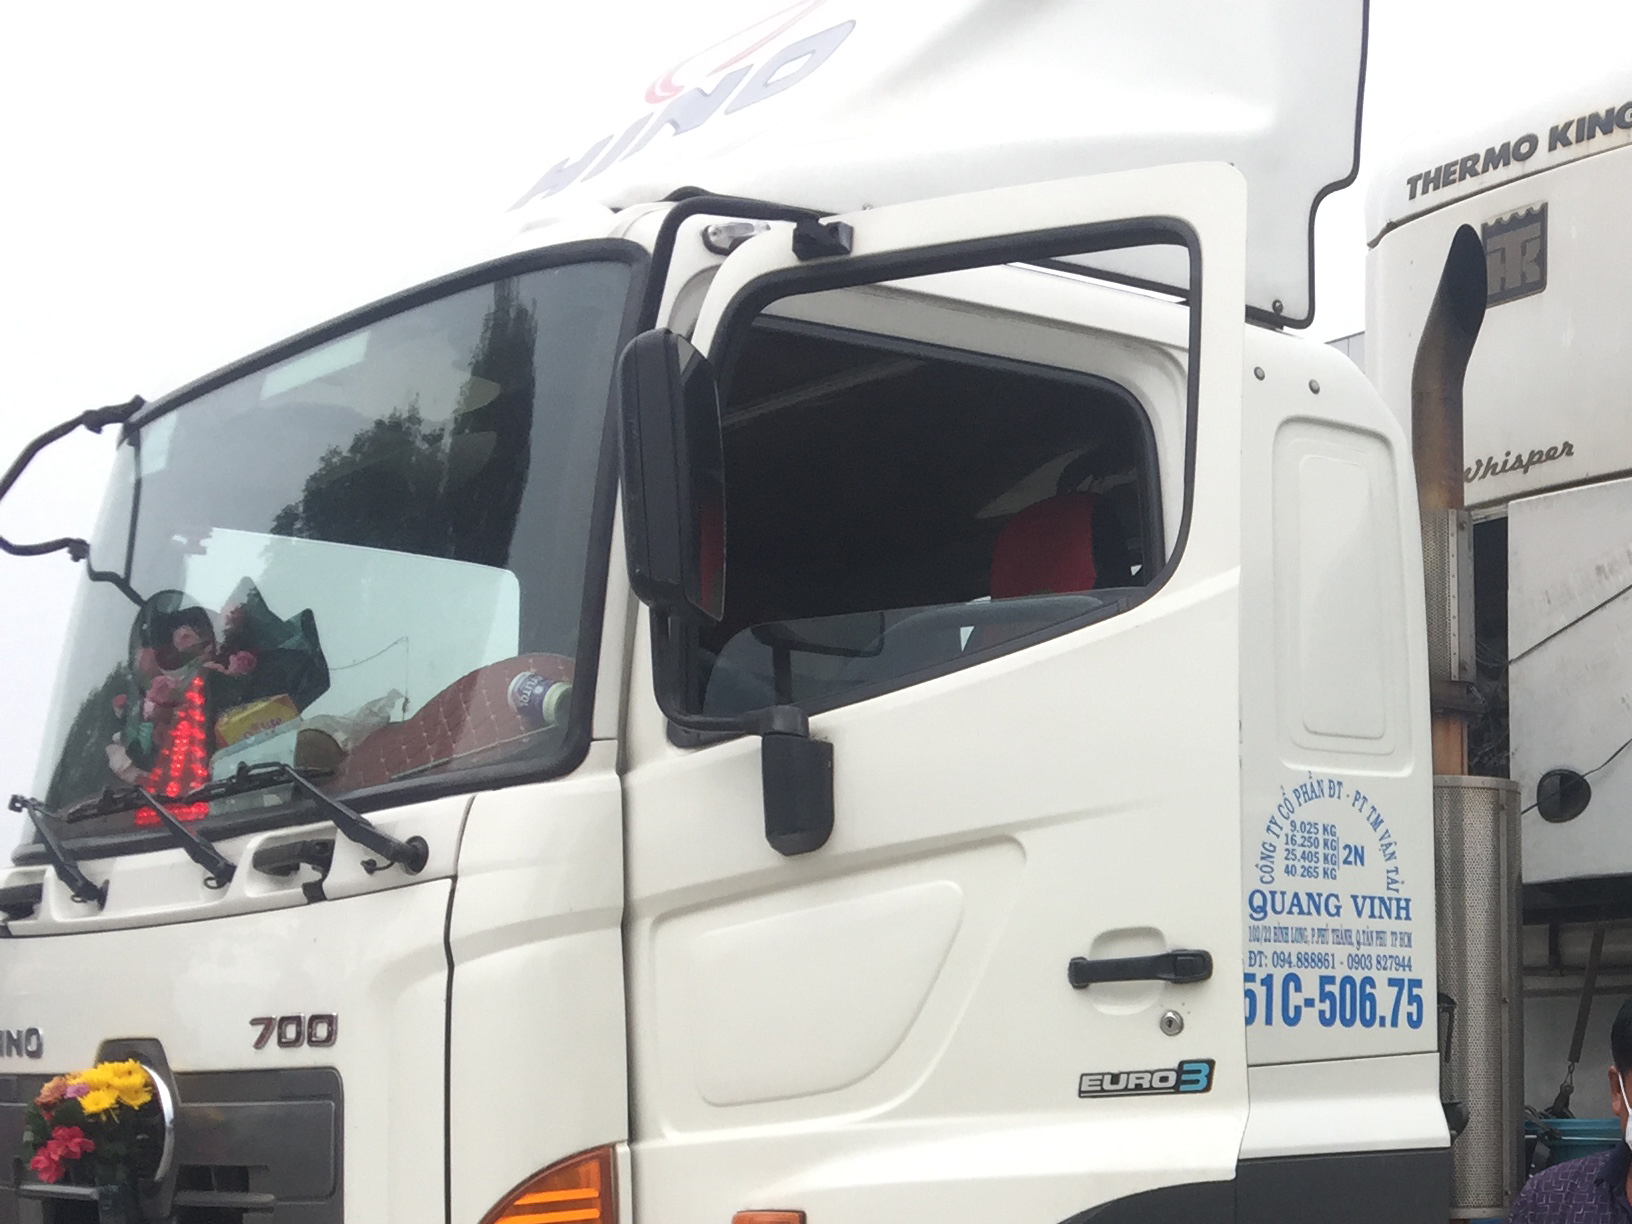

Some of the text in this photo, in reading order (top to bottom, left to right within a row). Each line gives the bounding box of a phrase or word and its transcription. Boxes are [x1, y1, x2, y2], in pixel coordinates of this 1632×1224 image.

[505, 20, 856, 213] HINO
[1406, 133, 1539, 201] THERMO
[1328, 779, 1343, 800] ĐT
[1352, 790, 1368, 813] PT
[1265, 815, 1284, 839] TY
[1290, 820, 1337, 837] 9.025 KG
[1366, 805, 1384, 832] TM
[1284, 833, 1337, 851] 16.250 KG
[1379, 829, 1397, 862] VẬN
[1255, 841, 1277, 885] CÔNG
[1284, 848, 1337, 866] 25.405 KG
[1342, 844, 1365, 867] 2N
[1284, 864, 1337, 880] 40.265 KG
[1248, 889, 1412, 921] QUANG VINH
[1248, 950, 1267, 967] ĐT:
[1244, 972, 1424, 1029] 51C-506.75
[249, 1012, 338, 1050] 700
